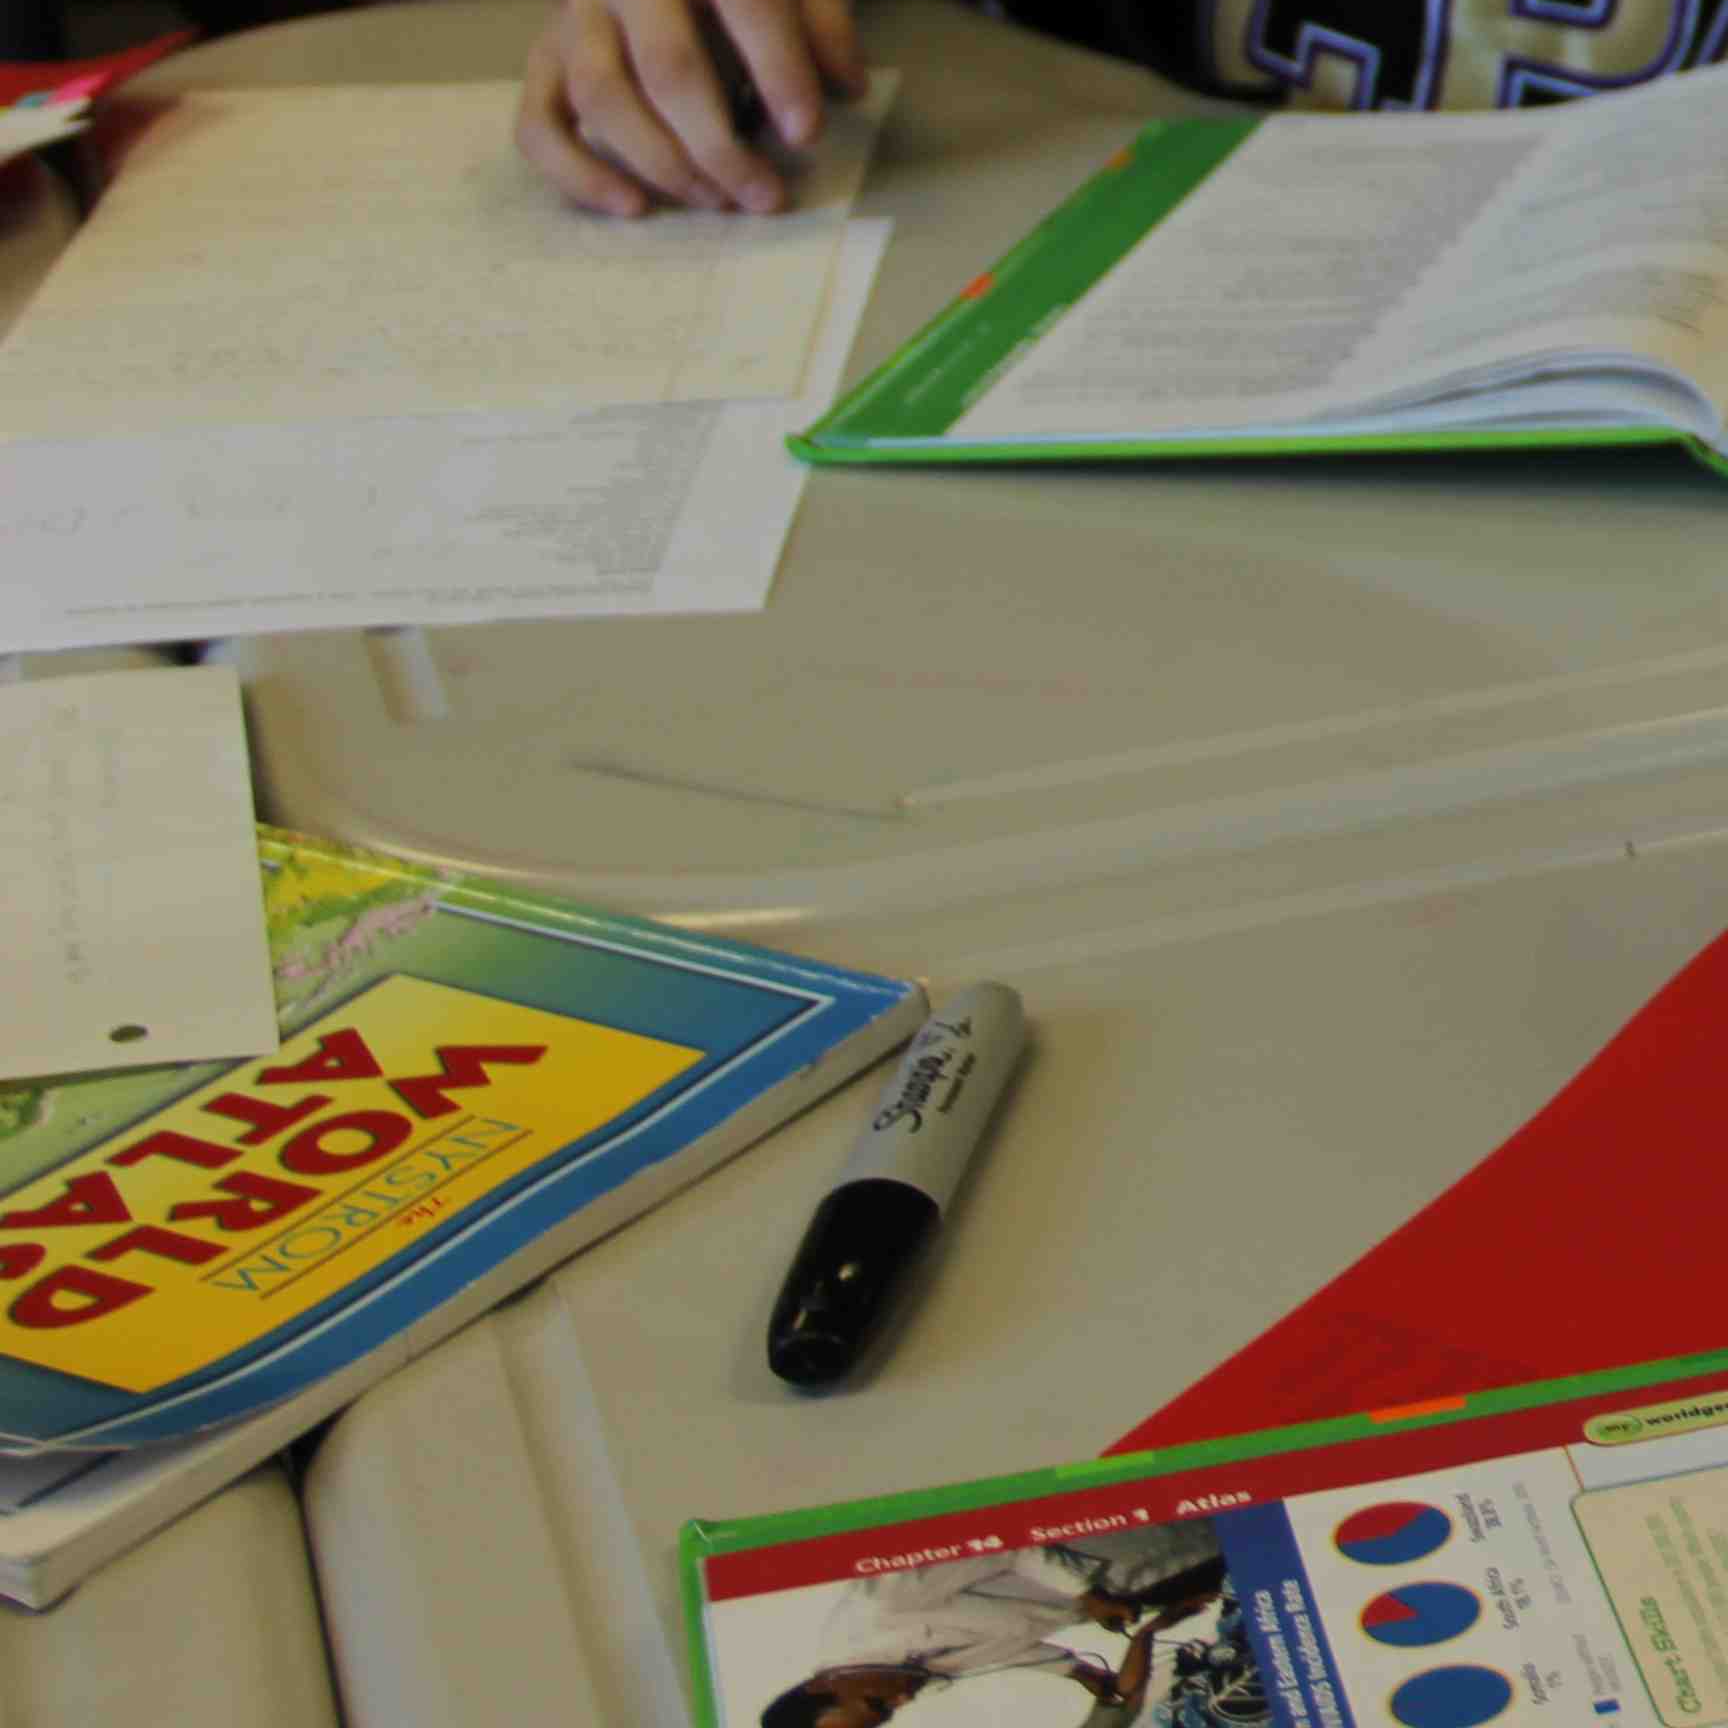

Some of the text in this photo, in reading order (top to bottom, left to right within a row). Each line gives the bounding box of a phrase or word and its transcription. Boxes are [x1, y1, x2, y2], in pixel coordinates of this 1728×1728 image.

[7, 1044, 548, 1329] WORLD
[213, 1117, 522, 1293] NYSTROM
[399, 1196, 451, 1229] The
[1175, 1489, 1253, 1516] Atlas
[1029, 1514, 1127, 1542] Section
[855, 1544, 962, 1574] Chapter
[1634, 1594, 1703, 1715] Chart Skills
